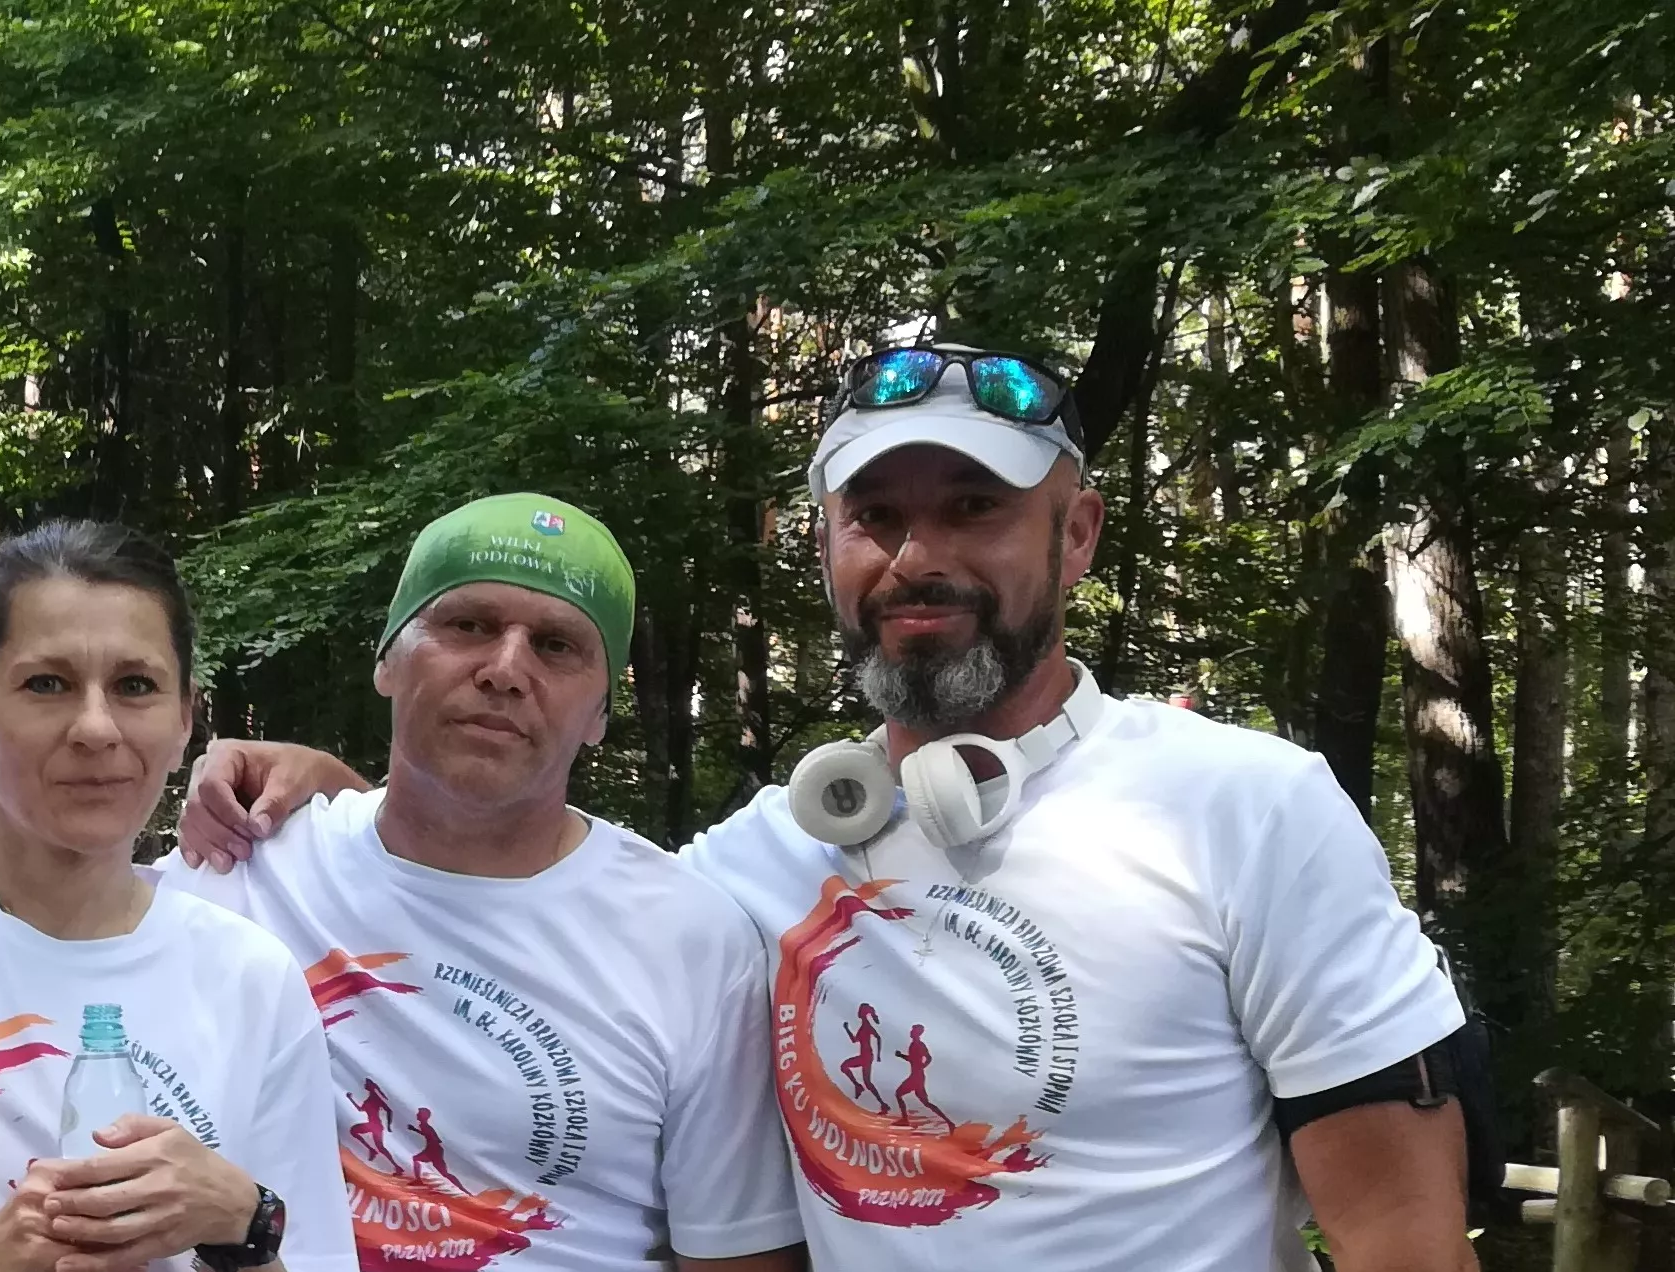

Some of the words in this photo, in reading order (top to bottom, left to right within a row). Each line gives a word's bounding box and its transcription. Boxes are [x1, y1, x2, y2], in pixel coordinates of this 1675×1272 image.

[490, 535, 542, 552] WILKI
[777, 1003, 797, 1070] BIEG
[784, 1072, 810, 1111] KU
